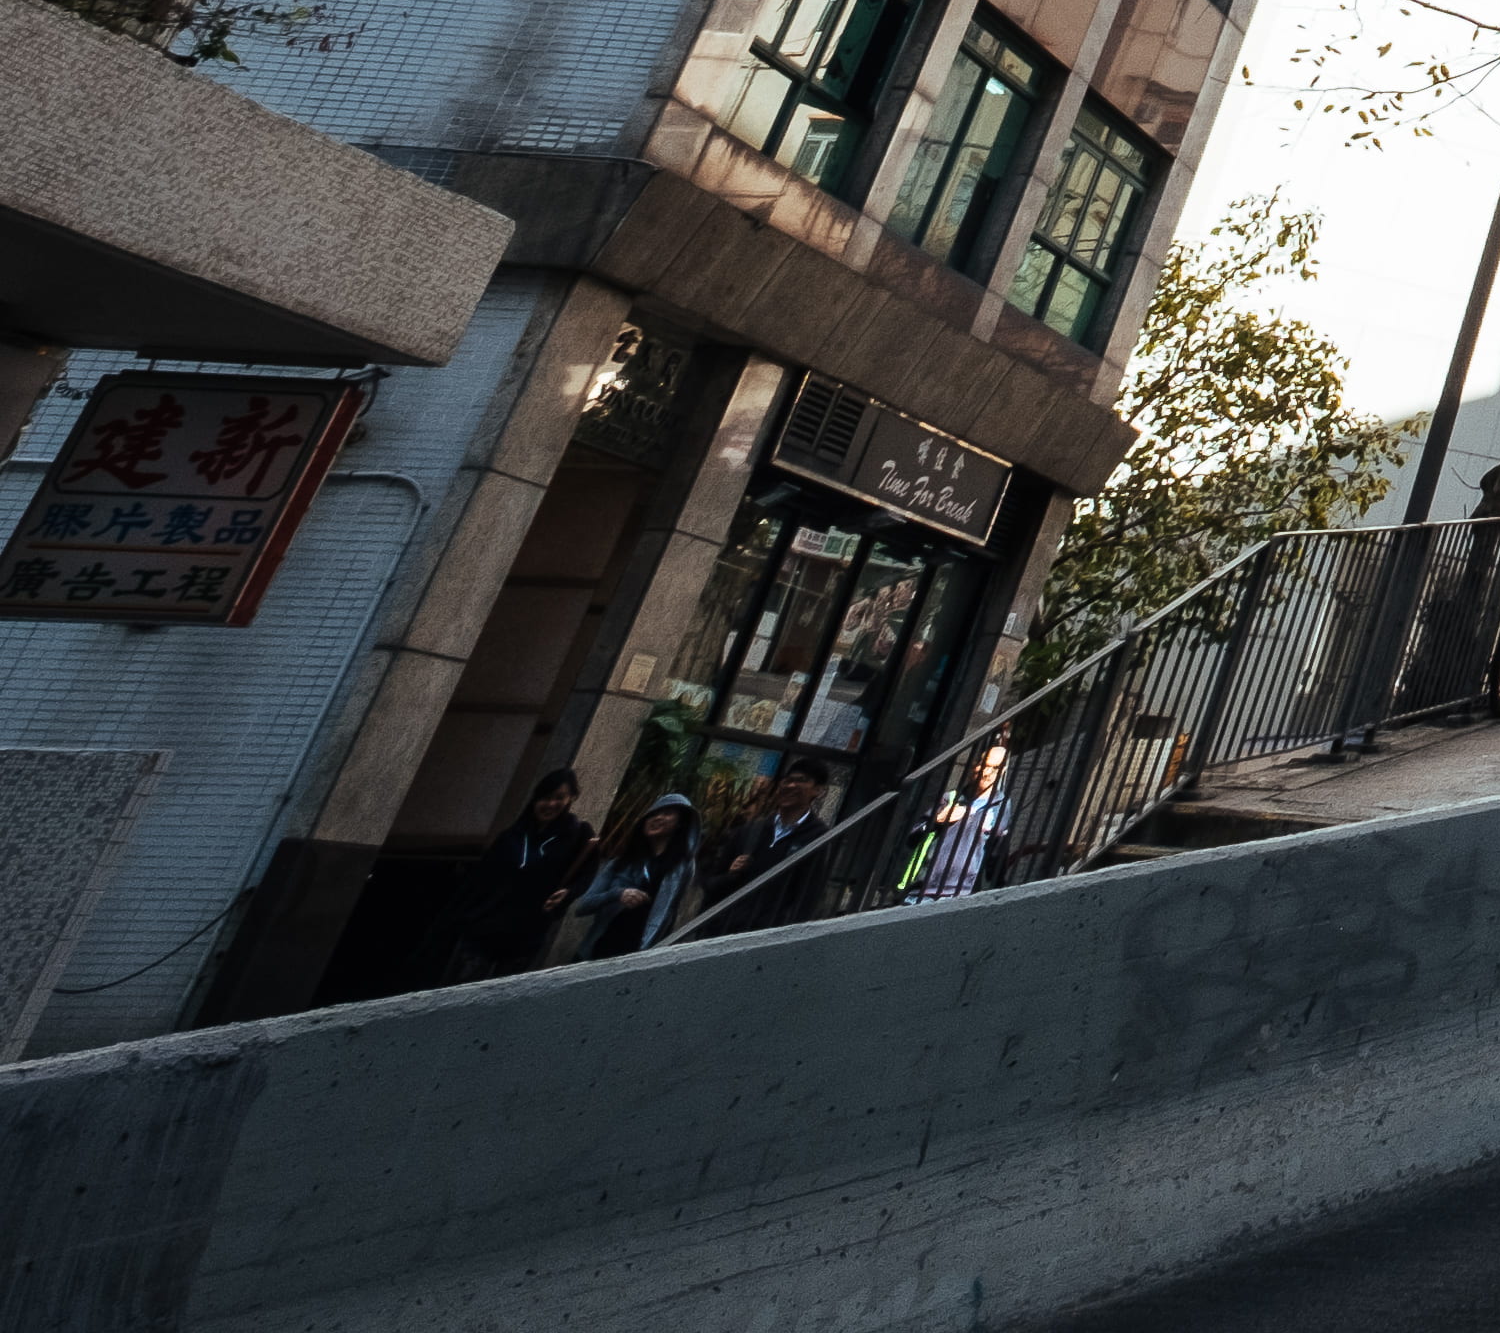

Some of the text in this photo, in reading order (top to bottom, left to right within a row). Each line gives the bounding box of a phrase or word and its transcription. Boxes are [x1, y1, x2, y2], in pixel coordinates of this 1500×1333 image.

[61, 393, 303, 496] 建新
[878, 459, 979, 525] Time For Break
[28, 502, 265, 547] 膠片製品
[0, 557, 233, 603] 廣告工程
